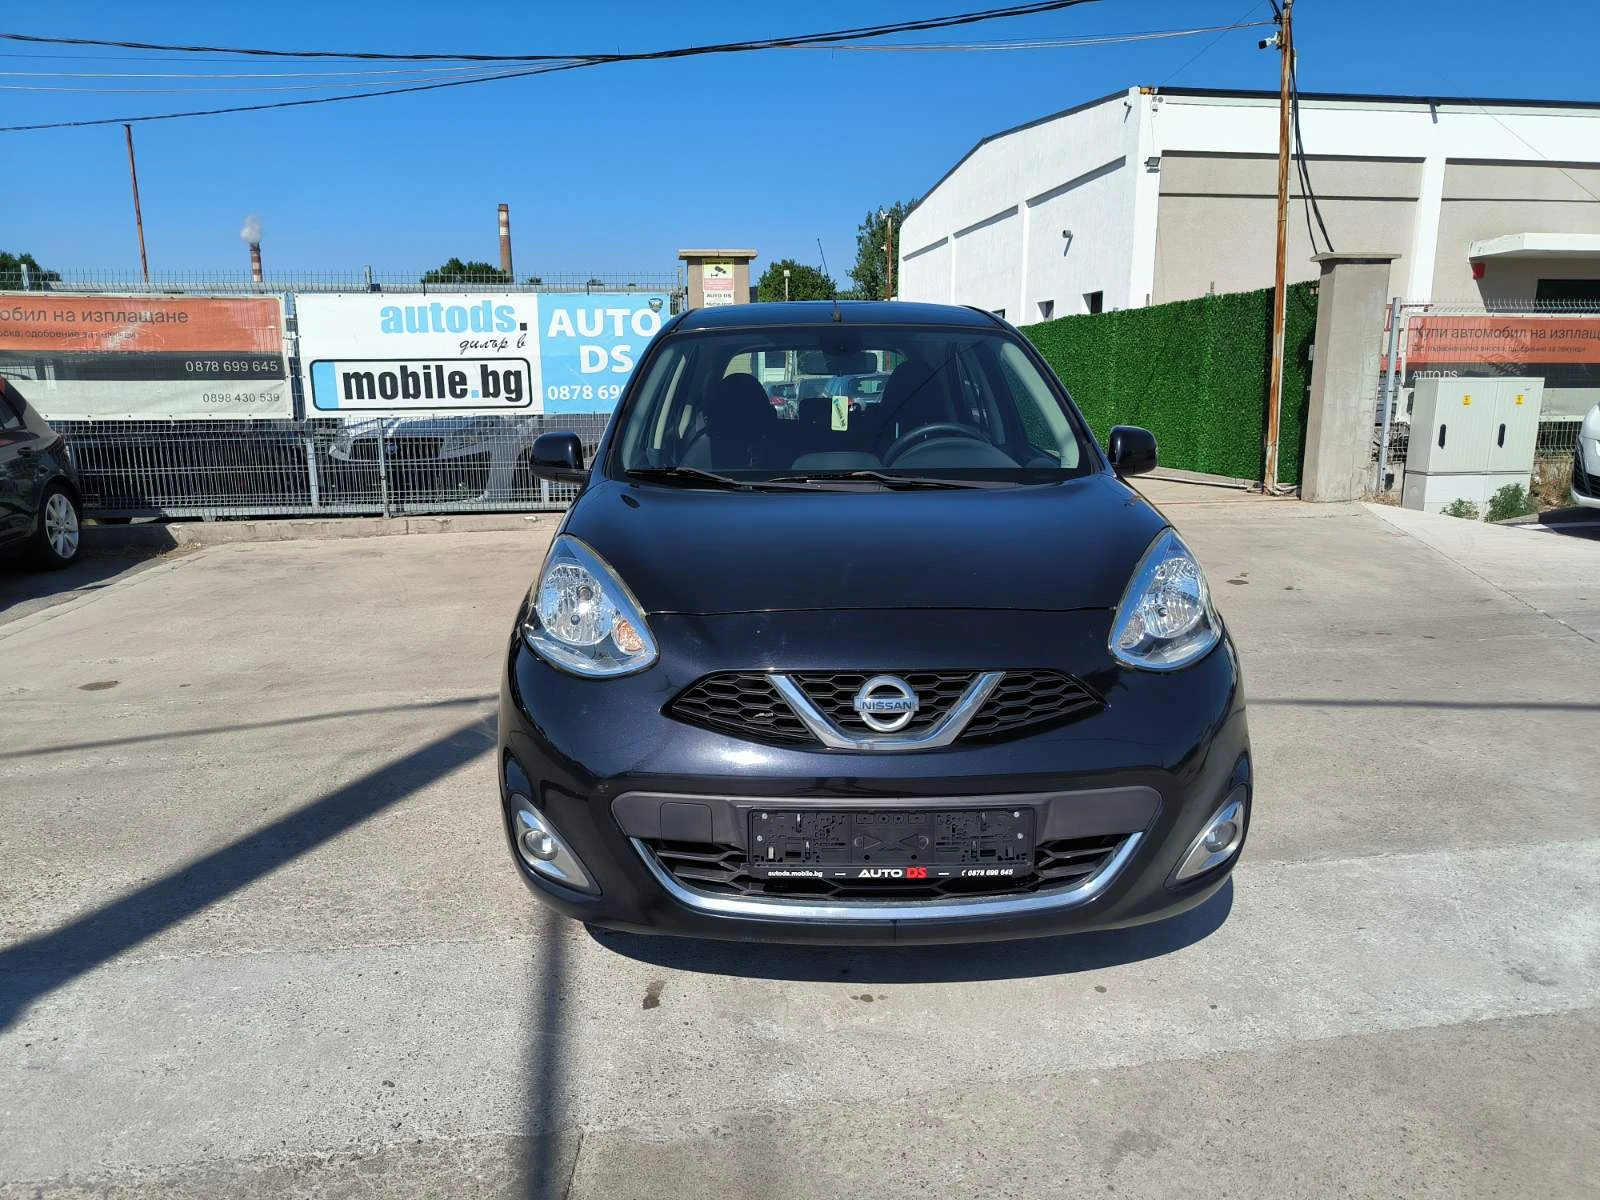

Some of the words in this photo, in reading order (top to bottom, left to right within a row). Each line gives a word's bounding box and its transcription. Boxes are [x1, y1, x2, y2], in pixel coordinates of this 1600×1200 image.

[53, 311, 76, 323] на
[82, 311, 189, 327] изплащане
[547, 308, 662, 337] AUTO
[1451, 325, 1527, 339] автомобил
[1530, 328, 1546, 338] на
[459, 337, 509, 355] дилър
[185, 361, 219, 372] 0878
[223, 361, 249, 372] 699
[252, 361, 278, 372] 645
[579, 344, 634, 374] DS
[342, 364, 523, 402] mobile.bg
[202, 393, 232, 403] 0898
[234, 393, 256, 403] 430
[259, 393, 280, 402] 539
[547, 385, 593, 400] 0878
[862, 701, 912, 710] NISSAN
[858, 869, 903, 878] AUTO
[906, 867, 927, 879] DS
